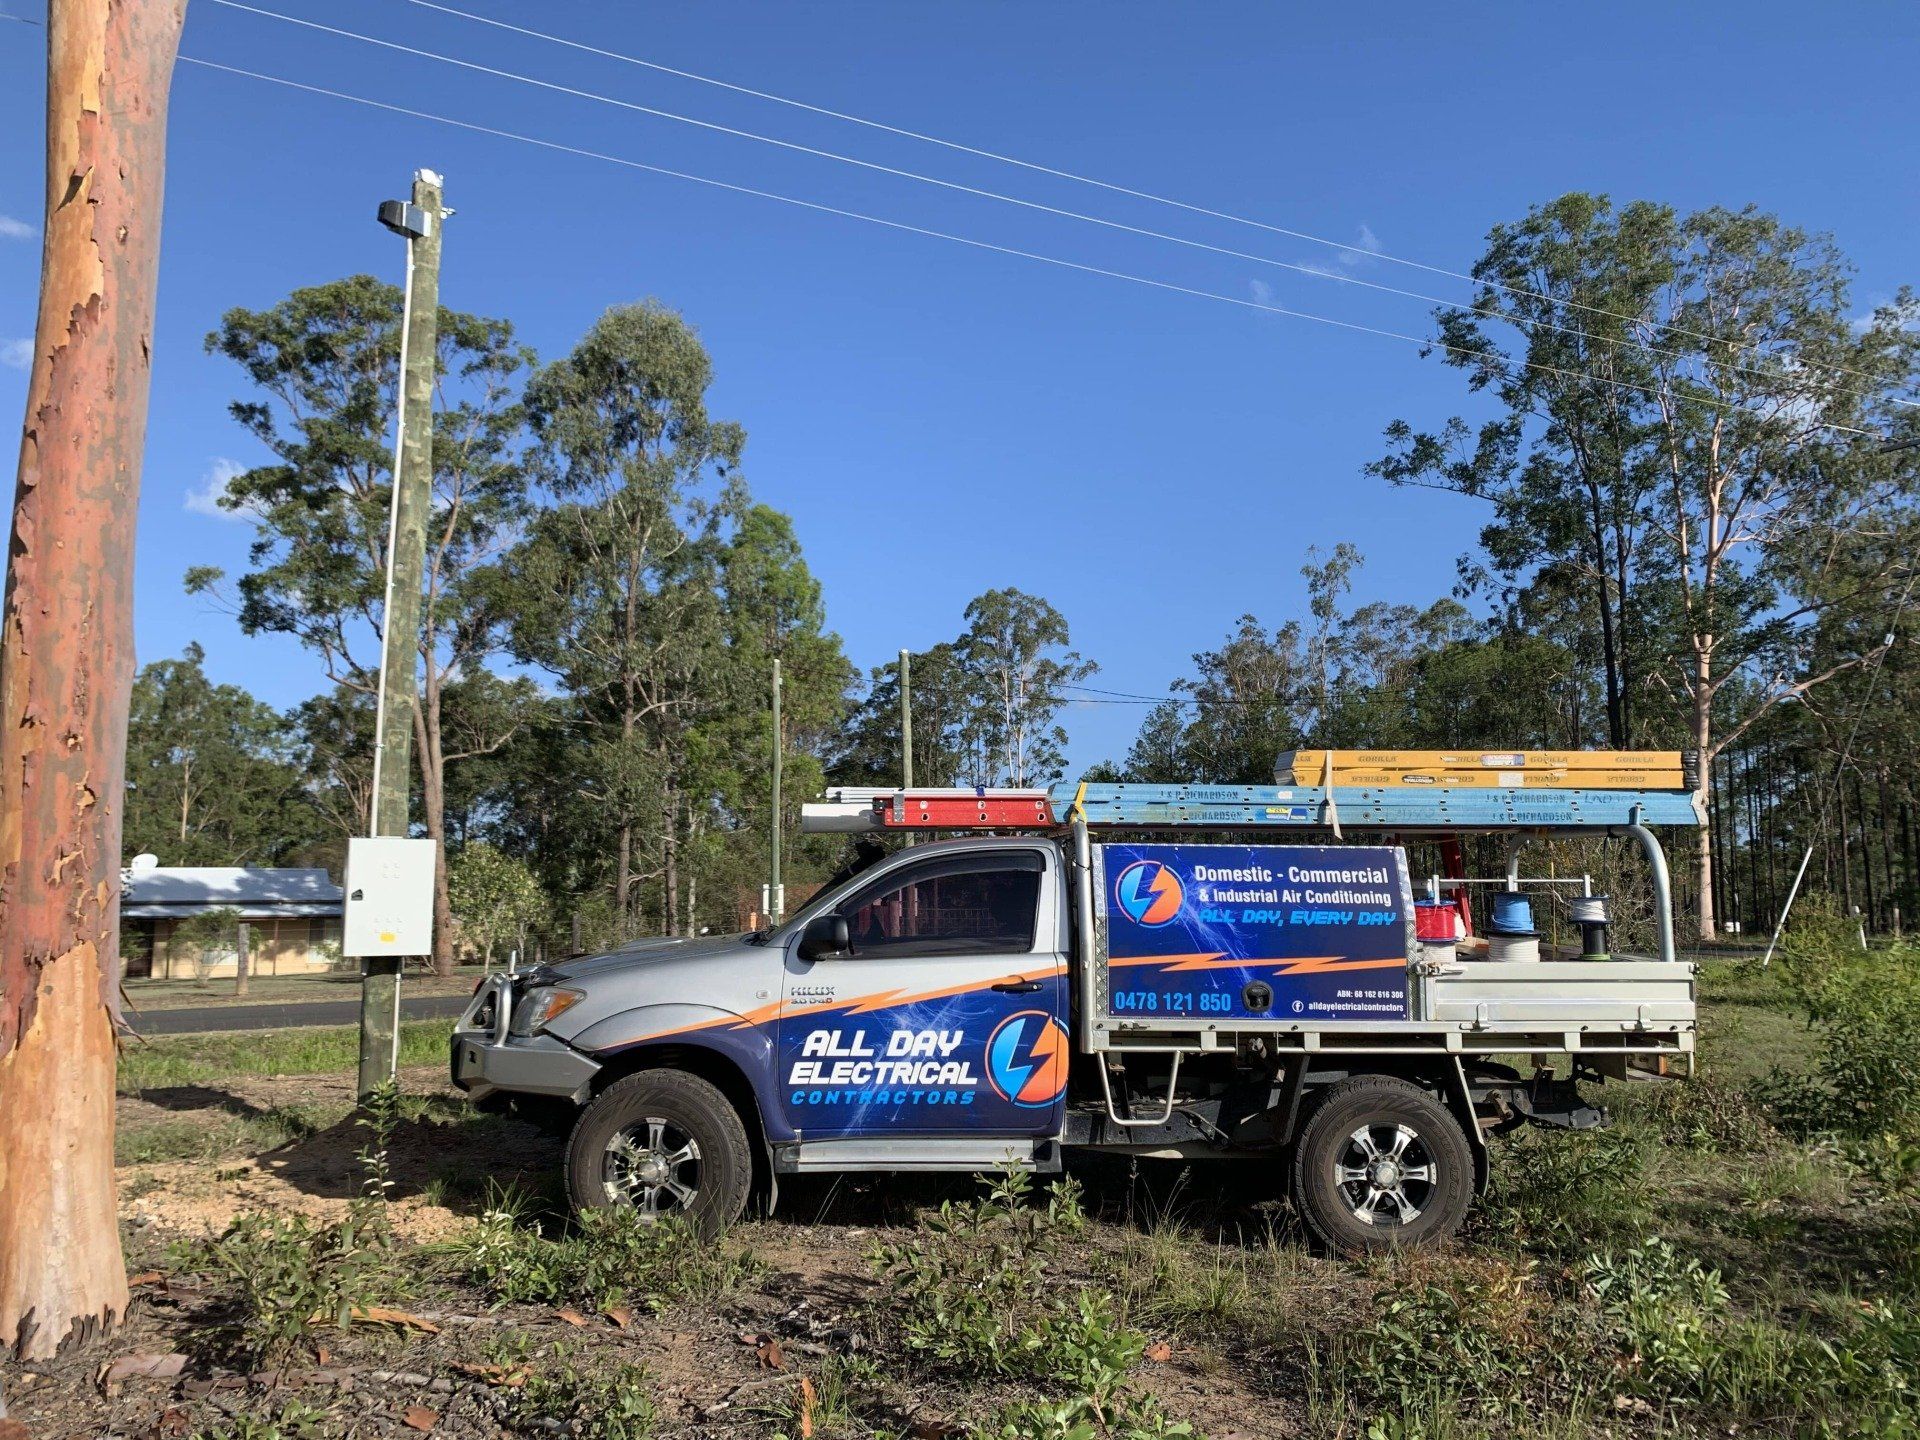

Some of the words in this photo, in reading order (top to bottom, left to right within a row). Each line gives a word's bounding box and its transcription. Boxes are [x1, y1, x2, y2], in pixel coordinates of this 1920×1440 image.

[1195, 865, 1272, 882] Domestic
[1288, 866, 1389, 883] Commercial
[1199, 888, 1209, 902] &
[1213, 888, 1278, 903] Industrial
[1282, 889, 1302, 903] Air
[1305, 889, 1392, 907] Conditioning
[1200, 909, 1236, 923] ALL
[1242, 909, 1284, 927] DAY,
[1290, 910, 1353, 926] EVERY
[1358, 911, 1397, 925] DAY
[790, 986, 835, 996] HILUX
[1337, 989, 1353, 998] ABN:
[1354, 990, 1363, 998] 68
[1364, 990, 1377, 998] 162
[1115, 991, 1158, 1010] 0478
[1163, 992, 1192, 1011] 121
[1200, 992, 1232, 1011] 850
[1308, 1002, 1404, 1012] alldayelectricalcontractors
[802, 1029, 875, 1057] ALL
[886, 1030, 964, 1057] DAY
[788, 1061, 978, 1085] ELECTRICAL
[790, 1090, 976, 1105] CONTRACTORS
